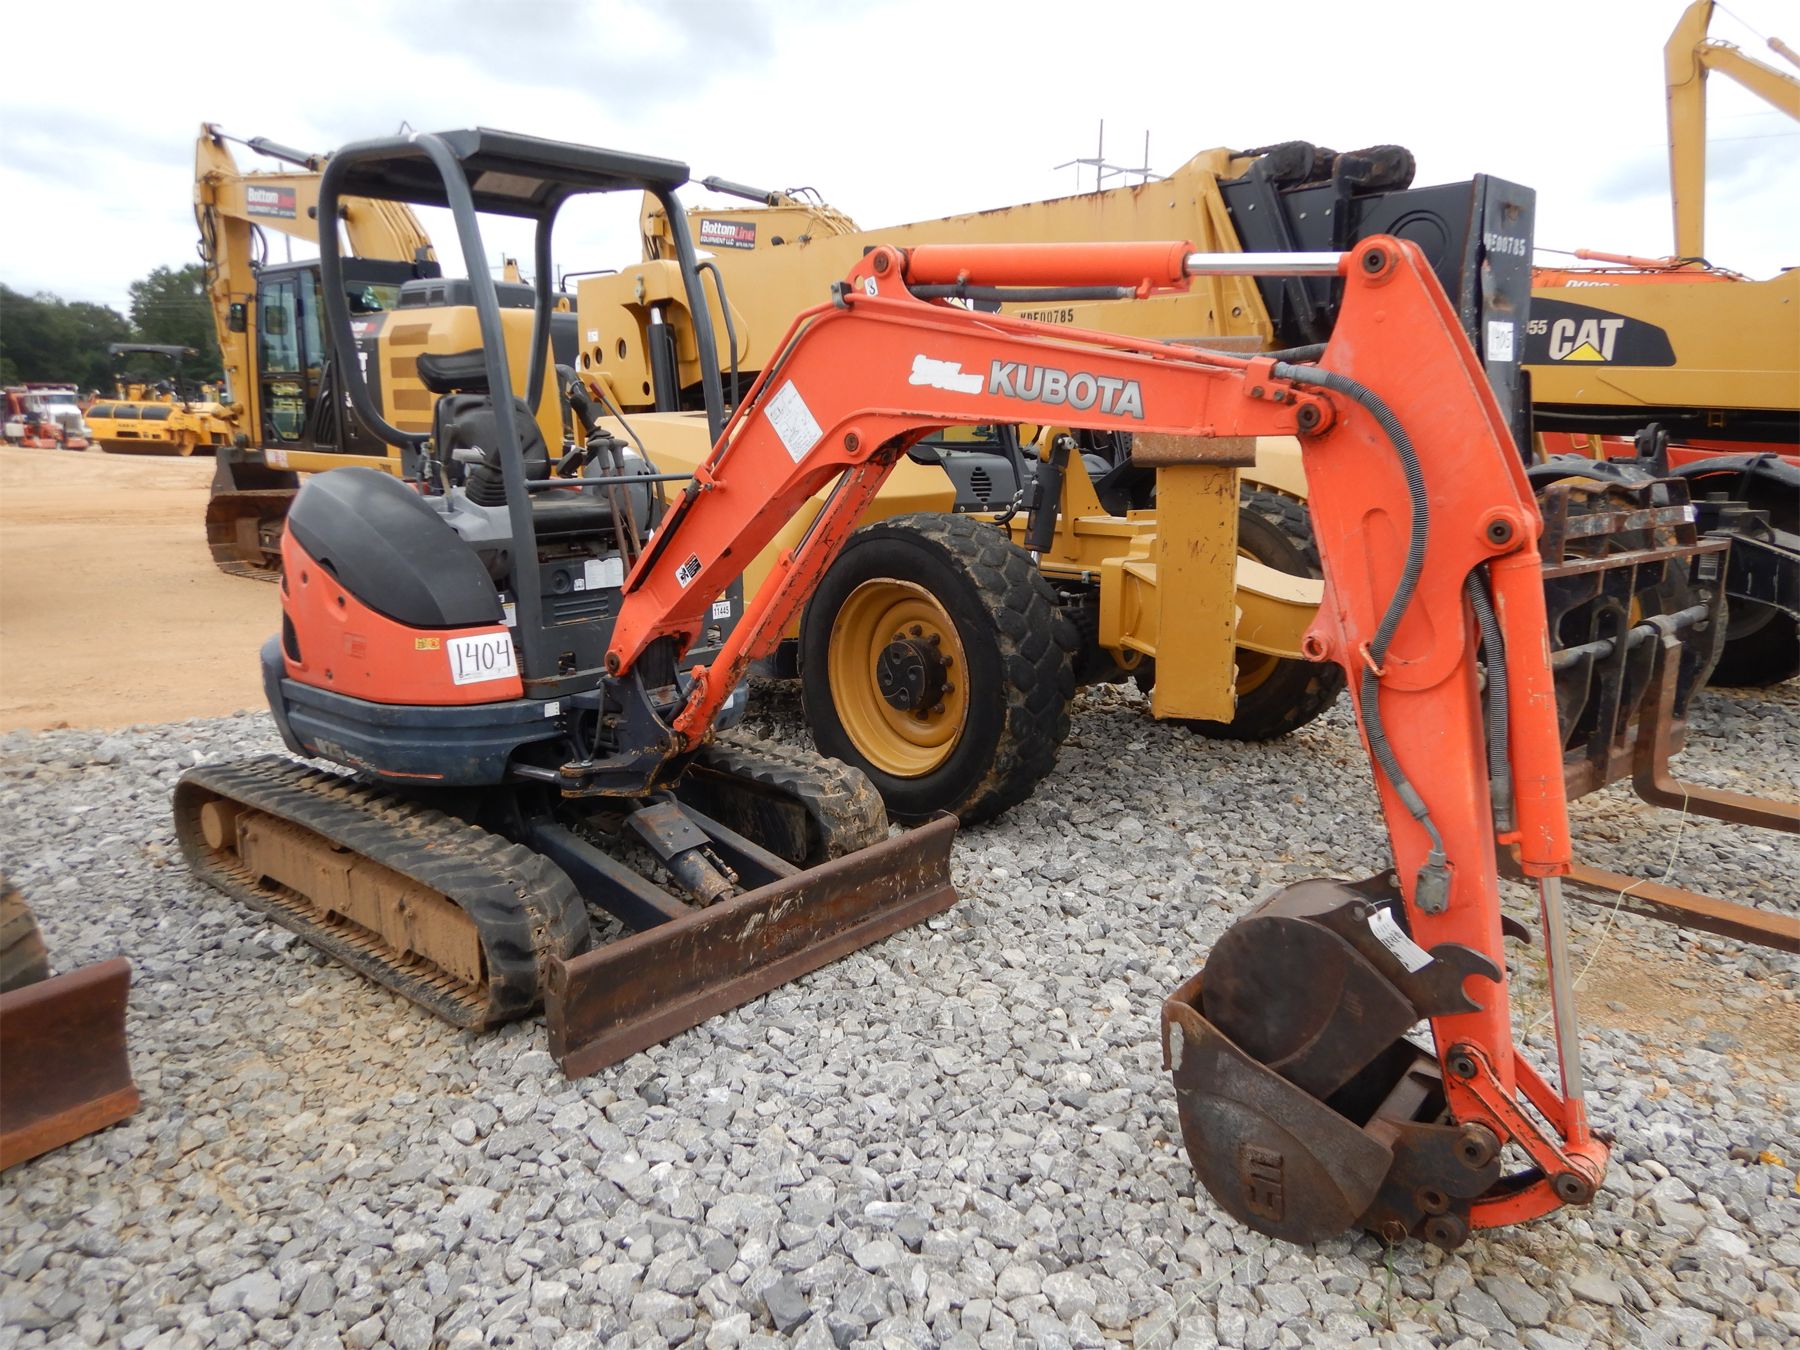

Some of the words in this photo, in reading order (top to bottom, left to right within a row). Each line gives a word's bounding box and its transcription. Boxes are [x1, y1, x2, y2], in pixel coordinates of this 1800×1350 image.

[1527, 320, 1548, 335] 55
[1549, 318, 1625, 361] CAT
[988, 359, 1145, 420] KUBOTA
[456, 639, 511, 676] 1404
